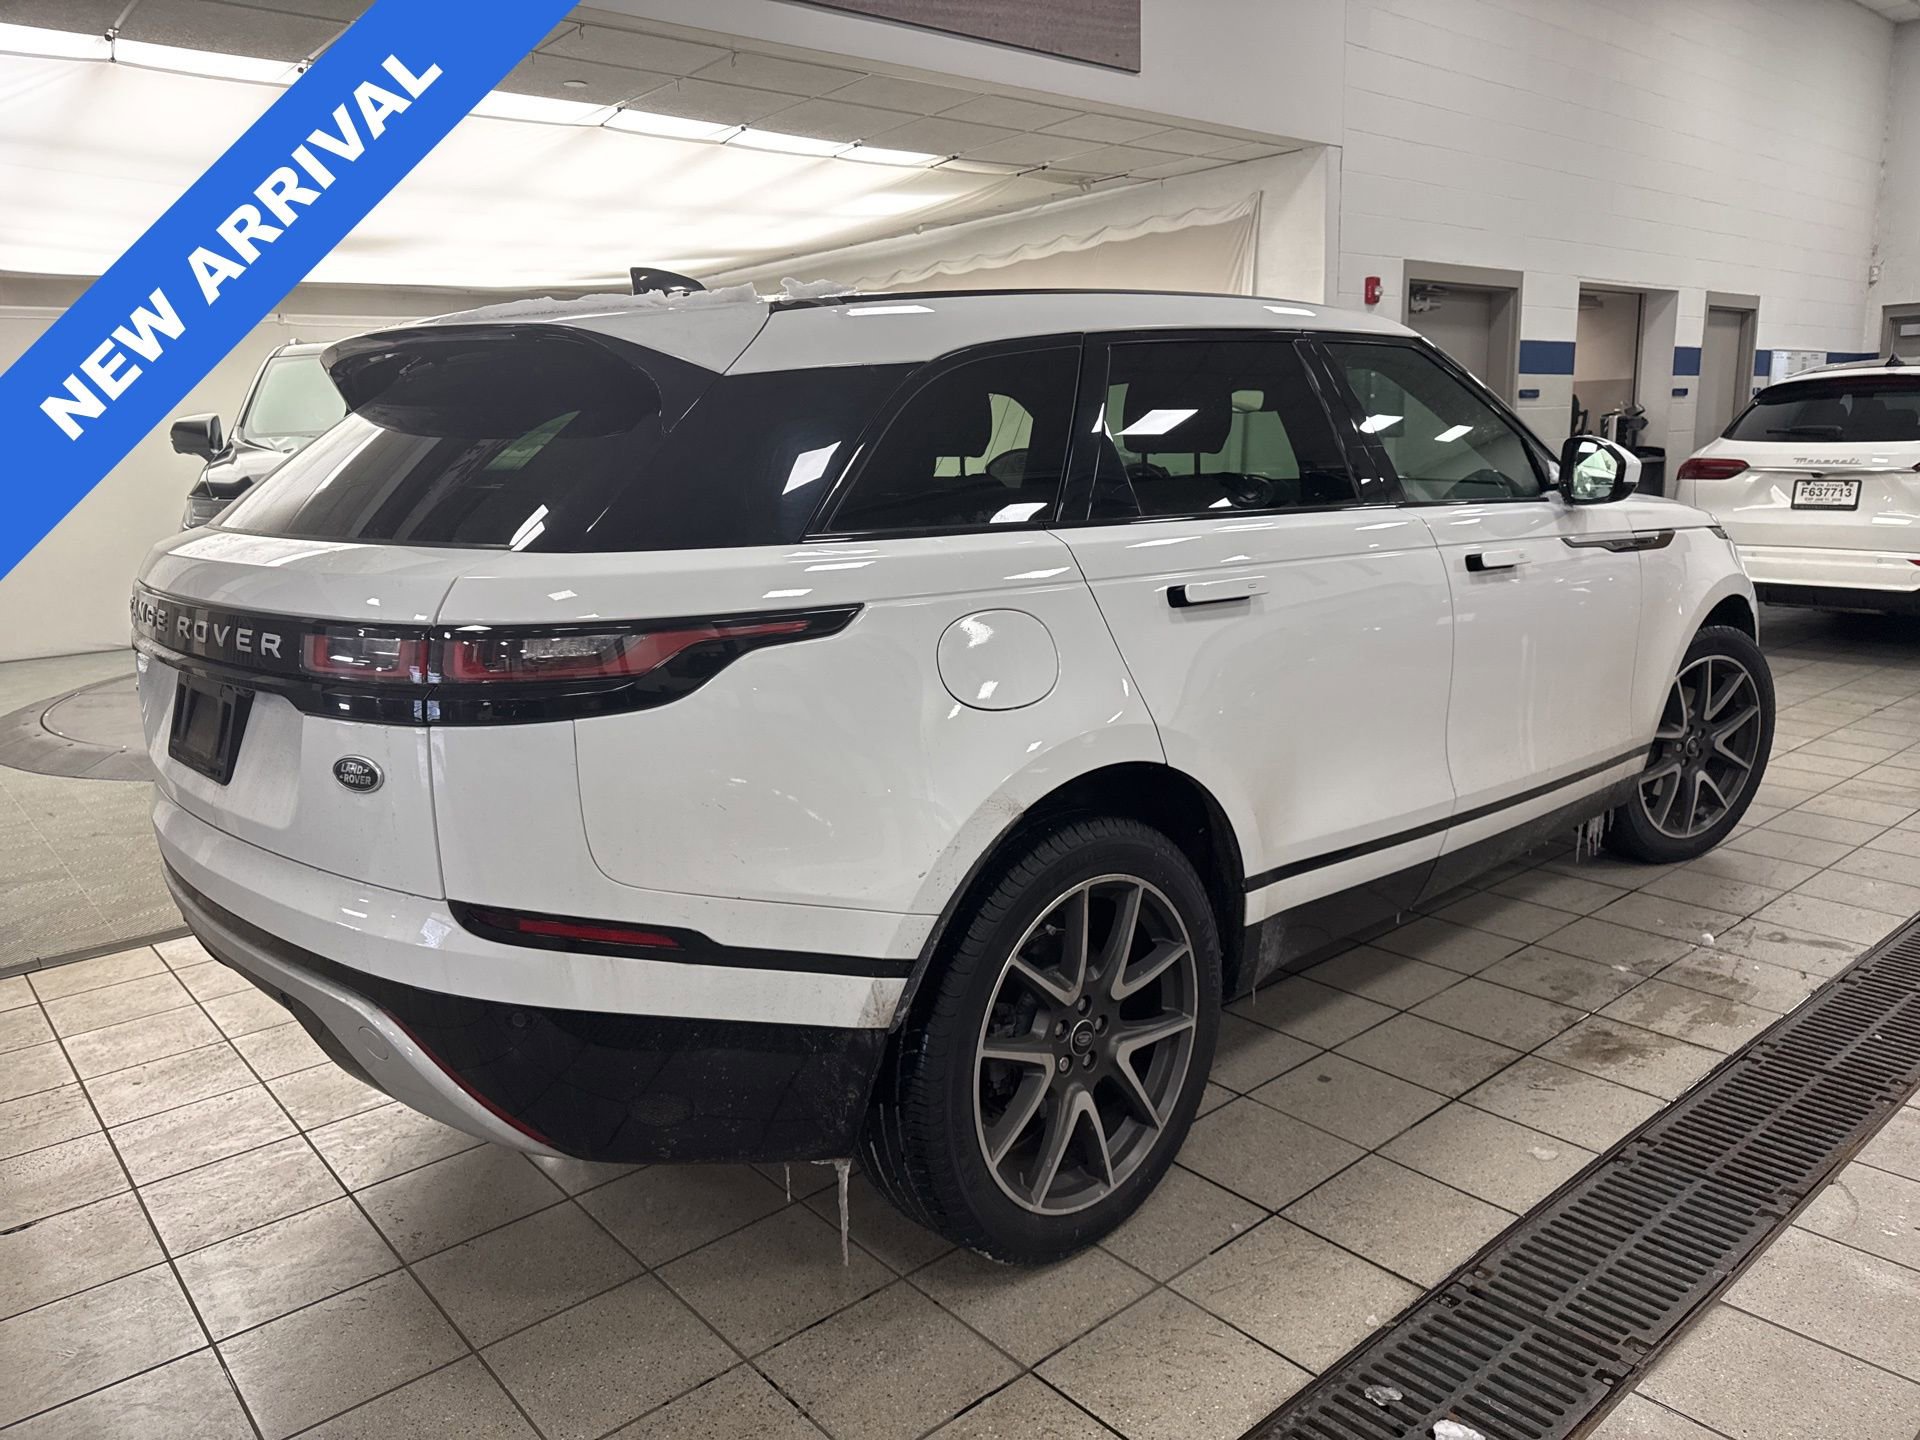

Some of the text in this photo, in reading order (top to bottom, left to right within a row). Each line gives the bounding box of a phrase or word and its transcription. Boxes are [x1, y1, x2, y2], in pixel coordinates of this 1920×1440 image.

[1800, 487, 1852, 498] F637713
[177, 615, 282, 659] ROVER
[341, 762, 363, 774] LAND
[343, 773, 372, 785] ROVER
